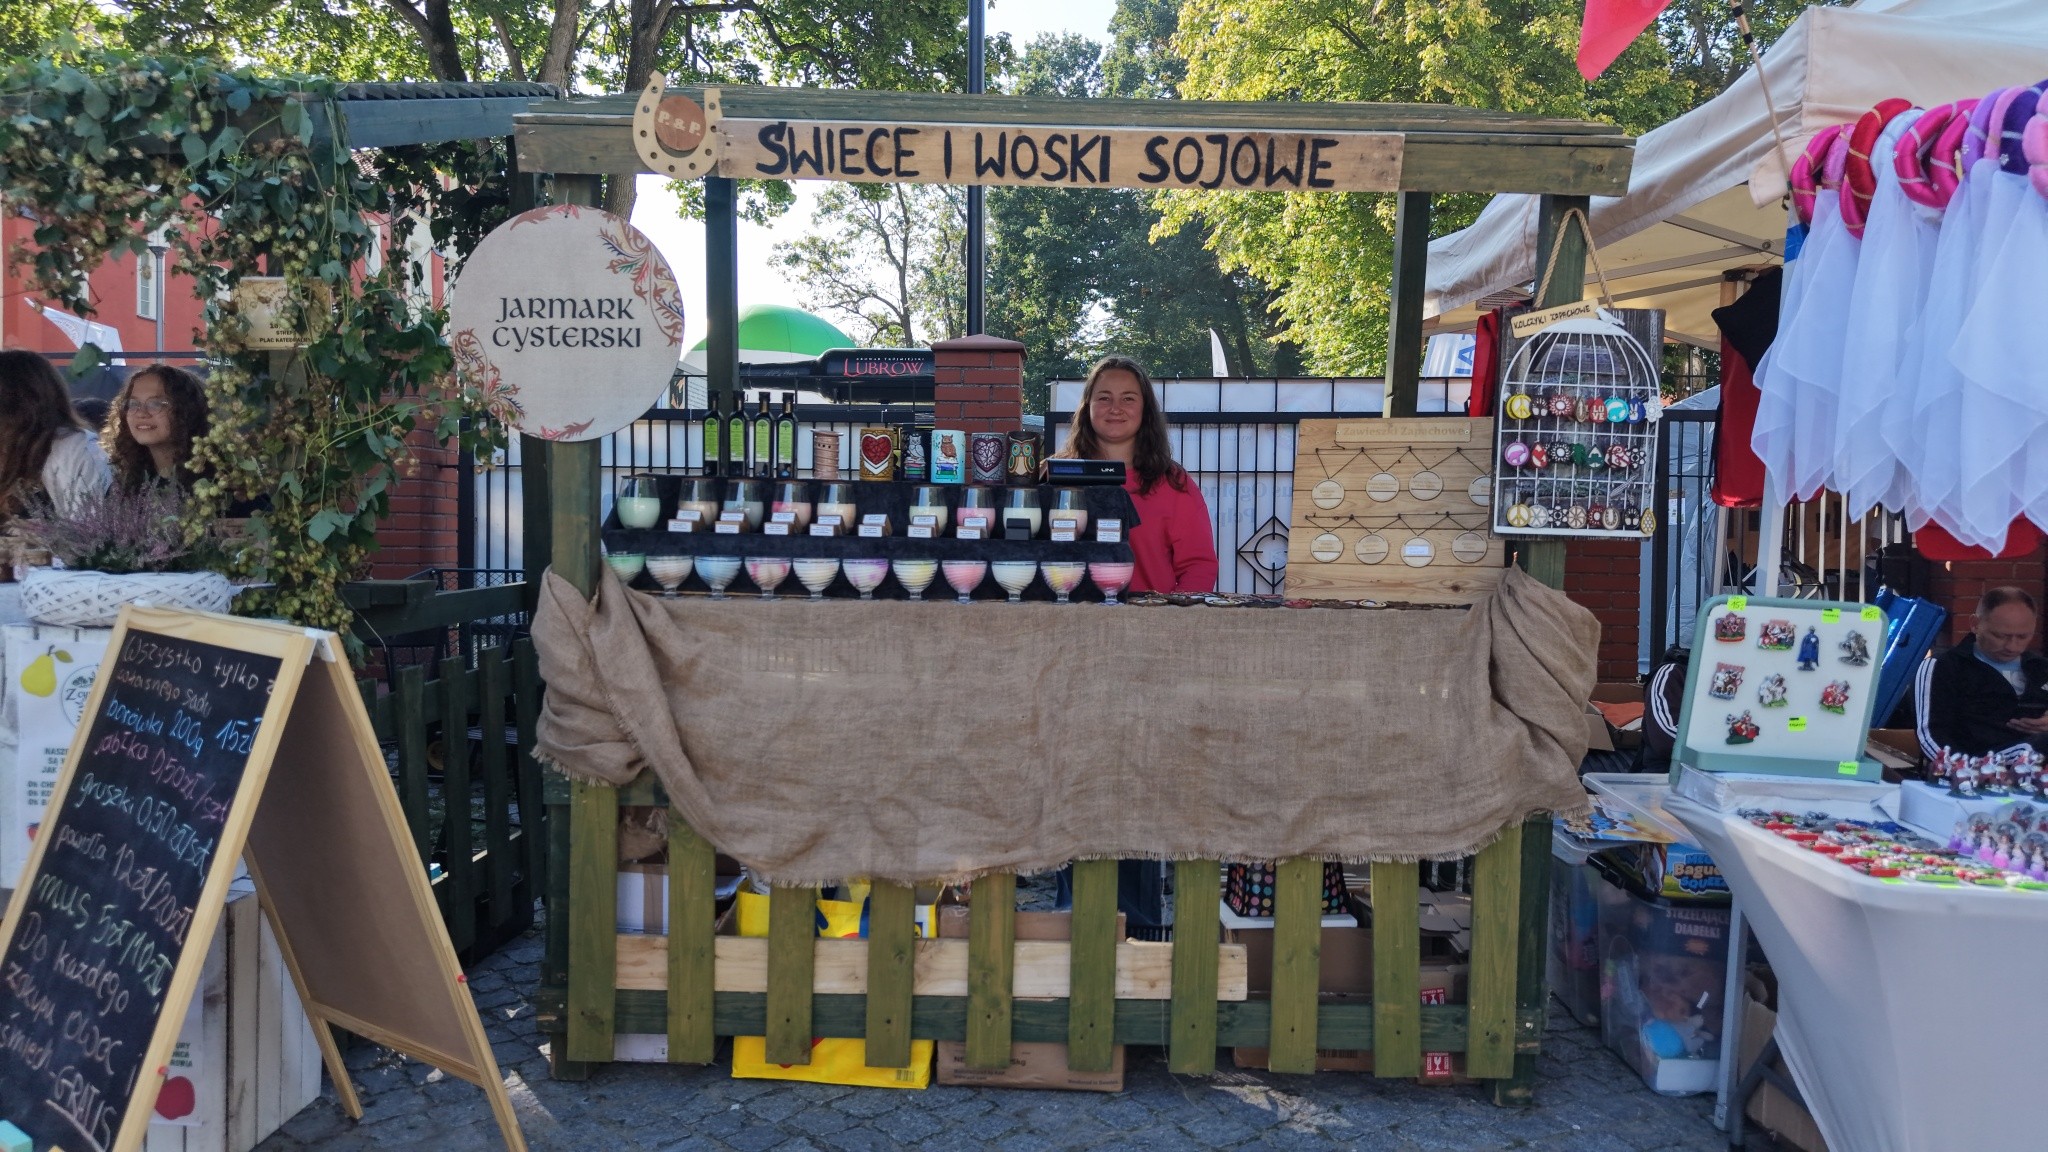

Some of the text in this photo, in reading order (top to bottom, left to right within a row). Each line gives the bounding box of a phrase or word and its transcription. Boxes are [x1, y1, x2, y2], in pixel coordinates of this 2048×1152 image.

[943, 130, 952, 180] I
[974, 131, 1112, 184] WOSKI
[1137, 133, 1340, 190] SOJOWE
[495, 297, 635, 323] JARMARK
[1513, 314, 1548, 330] KOLCZYKI
[492, 325, 641, 352] CYSTERSKI
[1343, 425, 1398, 436] Zawieszki
[214, 656, 259, 690] tylko
[19, 911, 48, 962] Do
